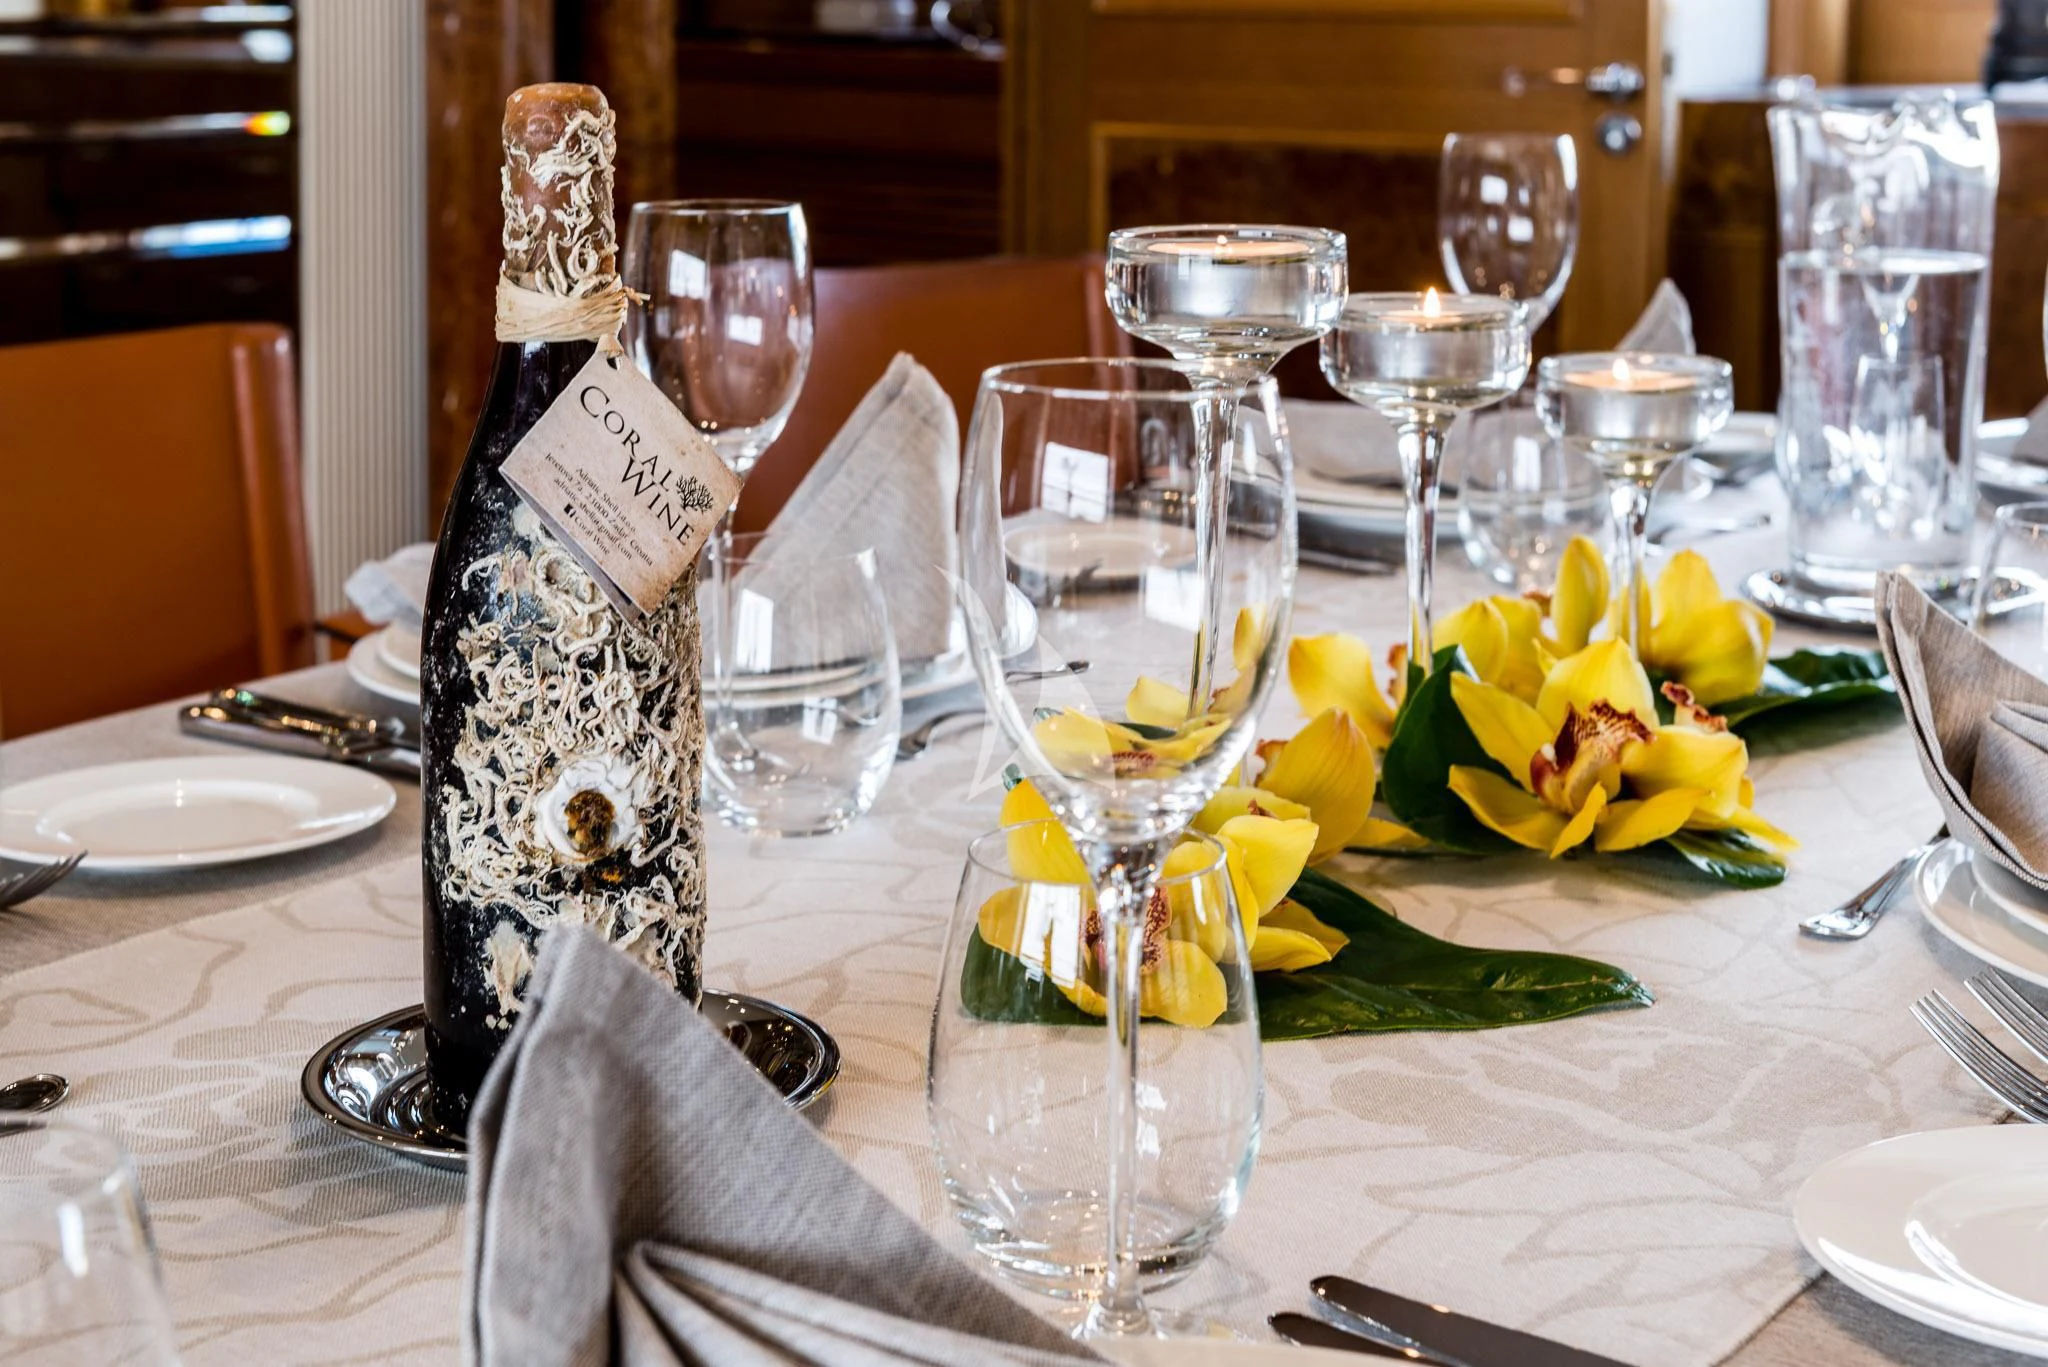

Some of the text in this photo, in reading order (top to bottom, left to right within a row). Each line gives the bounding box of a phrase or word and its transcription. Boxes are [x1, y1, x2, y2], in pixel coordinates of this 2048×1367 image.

[580, 385, 673, 493] CORAL
[576, 467, 600, 494] Adriatic
[601, 492, 619, 513] Shell
[621, 456, 695, 546] WINE
[574, 515, 594, 537] Coral
[592, 534, 610, 556] Wine
[629, 539, 653, 567] Croatia
